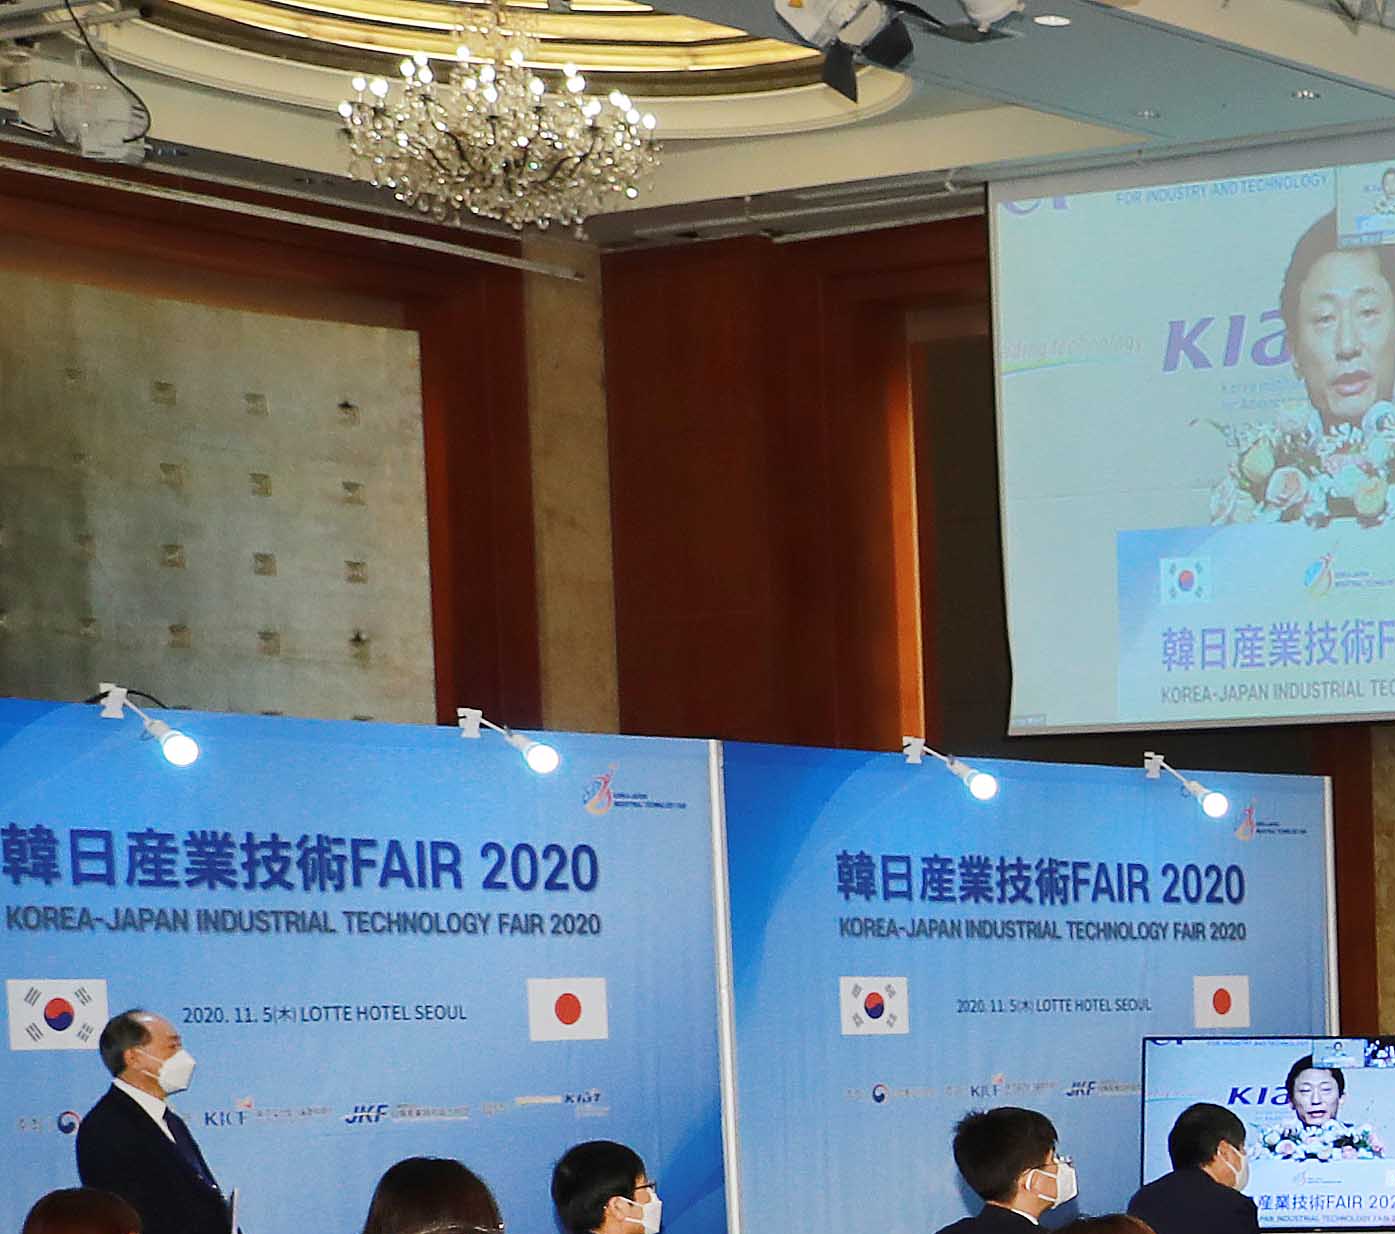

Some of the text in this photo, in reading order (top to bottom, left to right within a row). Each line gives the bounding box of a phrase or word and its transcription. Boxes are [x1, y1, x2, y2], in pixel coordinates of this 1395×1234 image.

[1162, 683, 1268, 705] KOREA-JAPAN
[1274, 680, 1364, 700] INDUSTRIAL
[1, 822, 599, 893] 韓日産業技術FAIR 2020
[836, 850, 1245, 906] 韓日産業技術FAIR 2020
[5, 905, 601, 936] KOREA-JAPAN INDUSTRIAL TECHNOLOGY FAIR 2020
[839, 916, 1246, 942] KOREA-JAPAN INDUSTRIAL TECHNOLOGY FAIR 2020
[183, 1006, 230, 1025] 2020.
[234, 1006, 259, 1025] 11.
[300, 1006, 351, 1023] LOTTE
[355, 1006, 411, 1022] HOTEL
[414, 1005, 467, 1021] SEOUL
[1036, 999, 1071, 1011] LOTTE
[1074, 1000, 1112, 1011] HOTEL
[1115, 999, 1151, 1011] SEOUL
[346, 1104, 389, 1124] JKF
[1259, 1194, 1362, 1210] 産業技術FAIR
